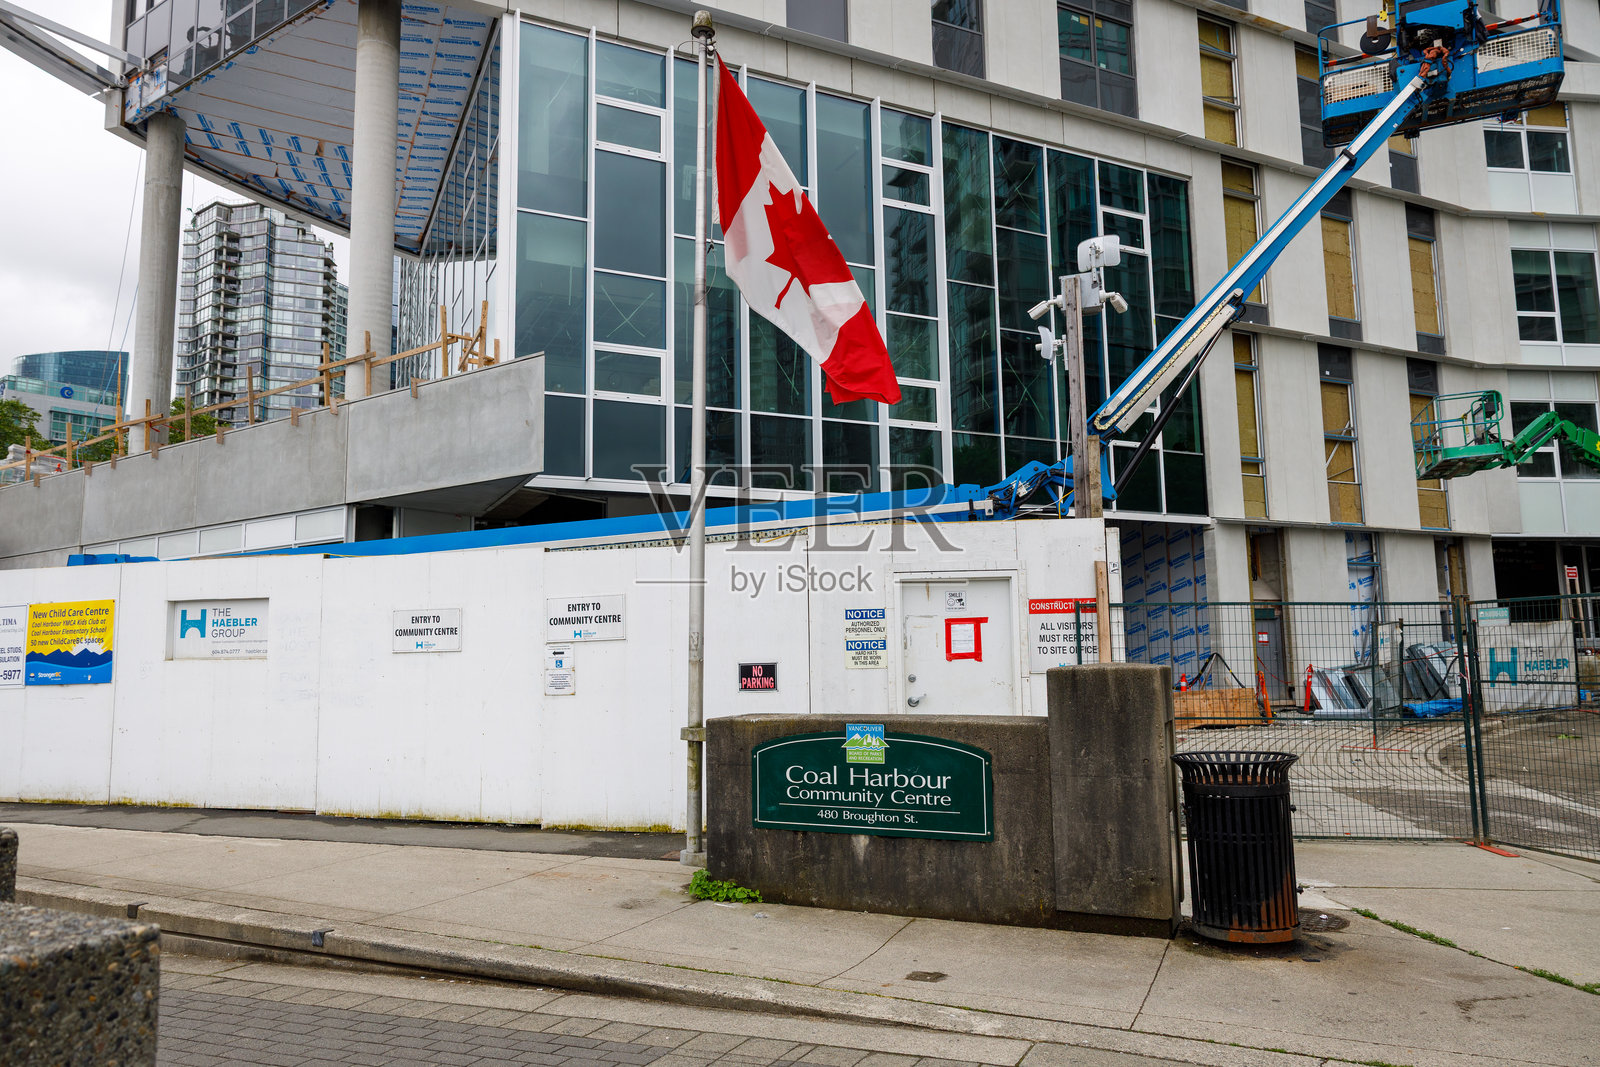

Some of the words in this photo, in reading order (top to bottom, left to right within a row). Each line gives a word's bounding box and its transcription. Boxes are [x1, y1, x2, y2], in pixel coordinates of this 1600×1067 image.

[212, 608, 231, 616] THE
[568, 603, 590, 612] ENTRY
[592, 602, 600, 611] TO
[33, 611, 47, 619] New
[49, 608, 66, 618] Child
[68, 608, 84, 617] Care
[85, 608, 110, 616] Centre
[847, 610, 884, 618] NOTICE
[212, 618, 258, 628] HAEBLER
[412, 616, 432, 624] ENTRY
[432, 616, 440, 624] TO
[550, 616, 593, 626] COMMUNITY
[594, 614, 622, 624] CENTRE
[1040, 622, 1055, 630] ALL
[1057, 622, 1094, 630] VISITRS
[62, 628, 89, 636] Elementary
[211, 628, 246, 638] GROUP
[395, 628, 434, 637] COMMUNITY
[434, 627, 458, 636] CENTRE
[50, 638, 83, 646] ChildCareBC
[1040, 634, 1060, 642] MUST
[848, 641, 884, 650] NOTICE
[1038, 646, 1048, 654] TO
[1050, 646, 1067, 654] SITE
[1069, 646, 1098, 654] OFICE
[1524, 658, 1569, 672] HAEBLER
[752, 666, 763, 677] NO
[742, 677, 774, 688] PARKING
[785, 765, 838, 786] Coal
[849, 767, 952, 790] Harbour
[786, 785, 884, 808] Community
[890, 790, 952, 806] Centre
[817, 810, 838, 820] 480
[843, 810, 900, 824] Broughton
[904, 813, 919, 824] St.
